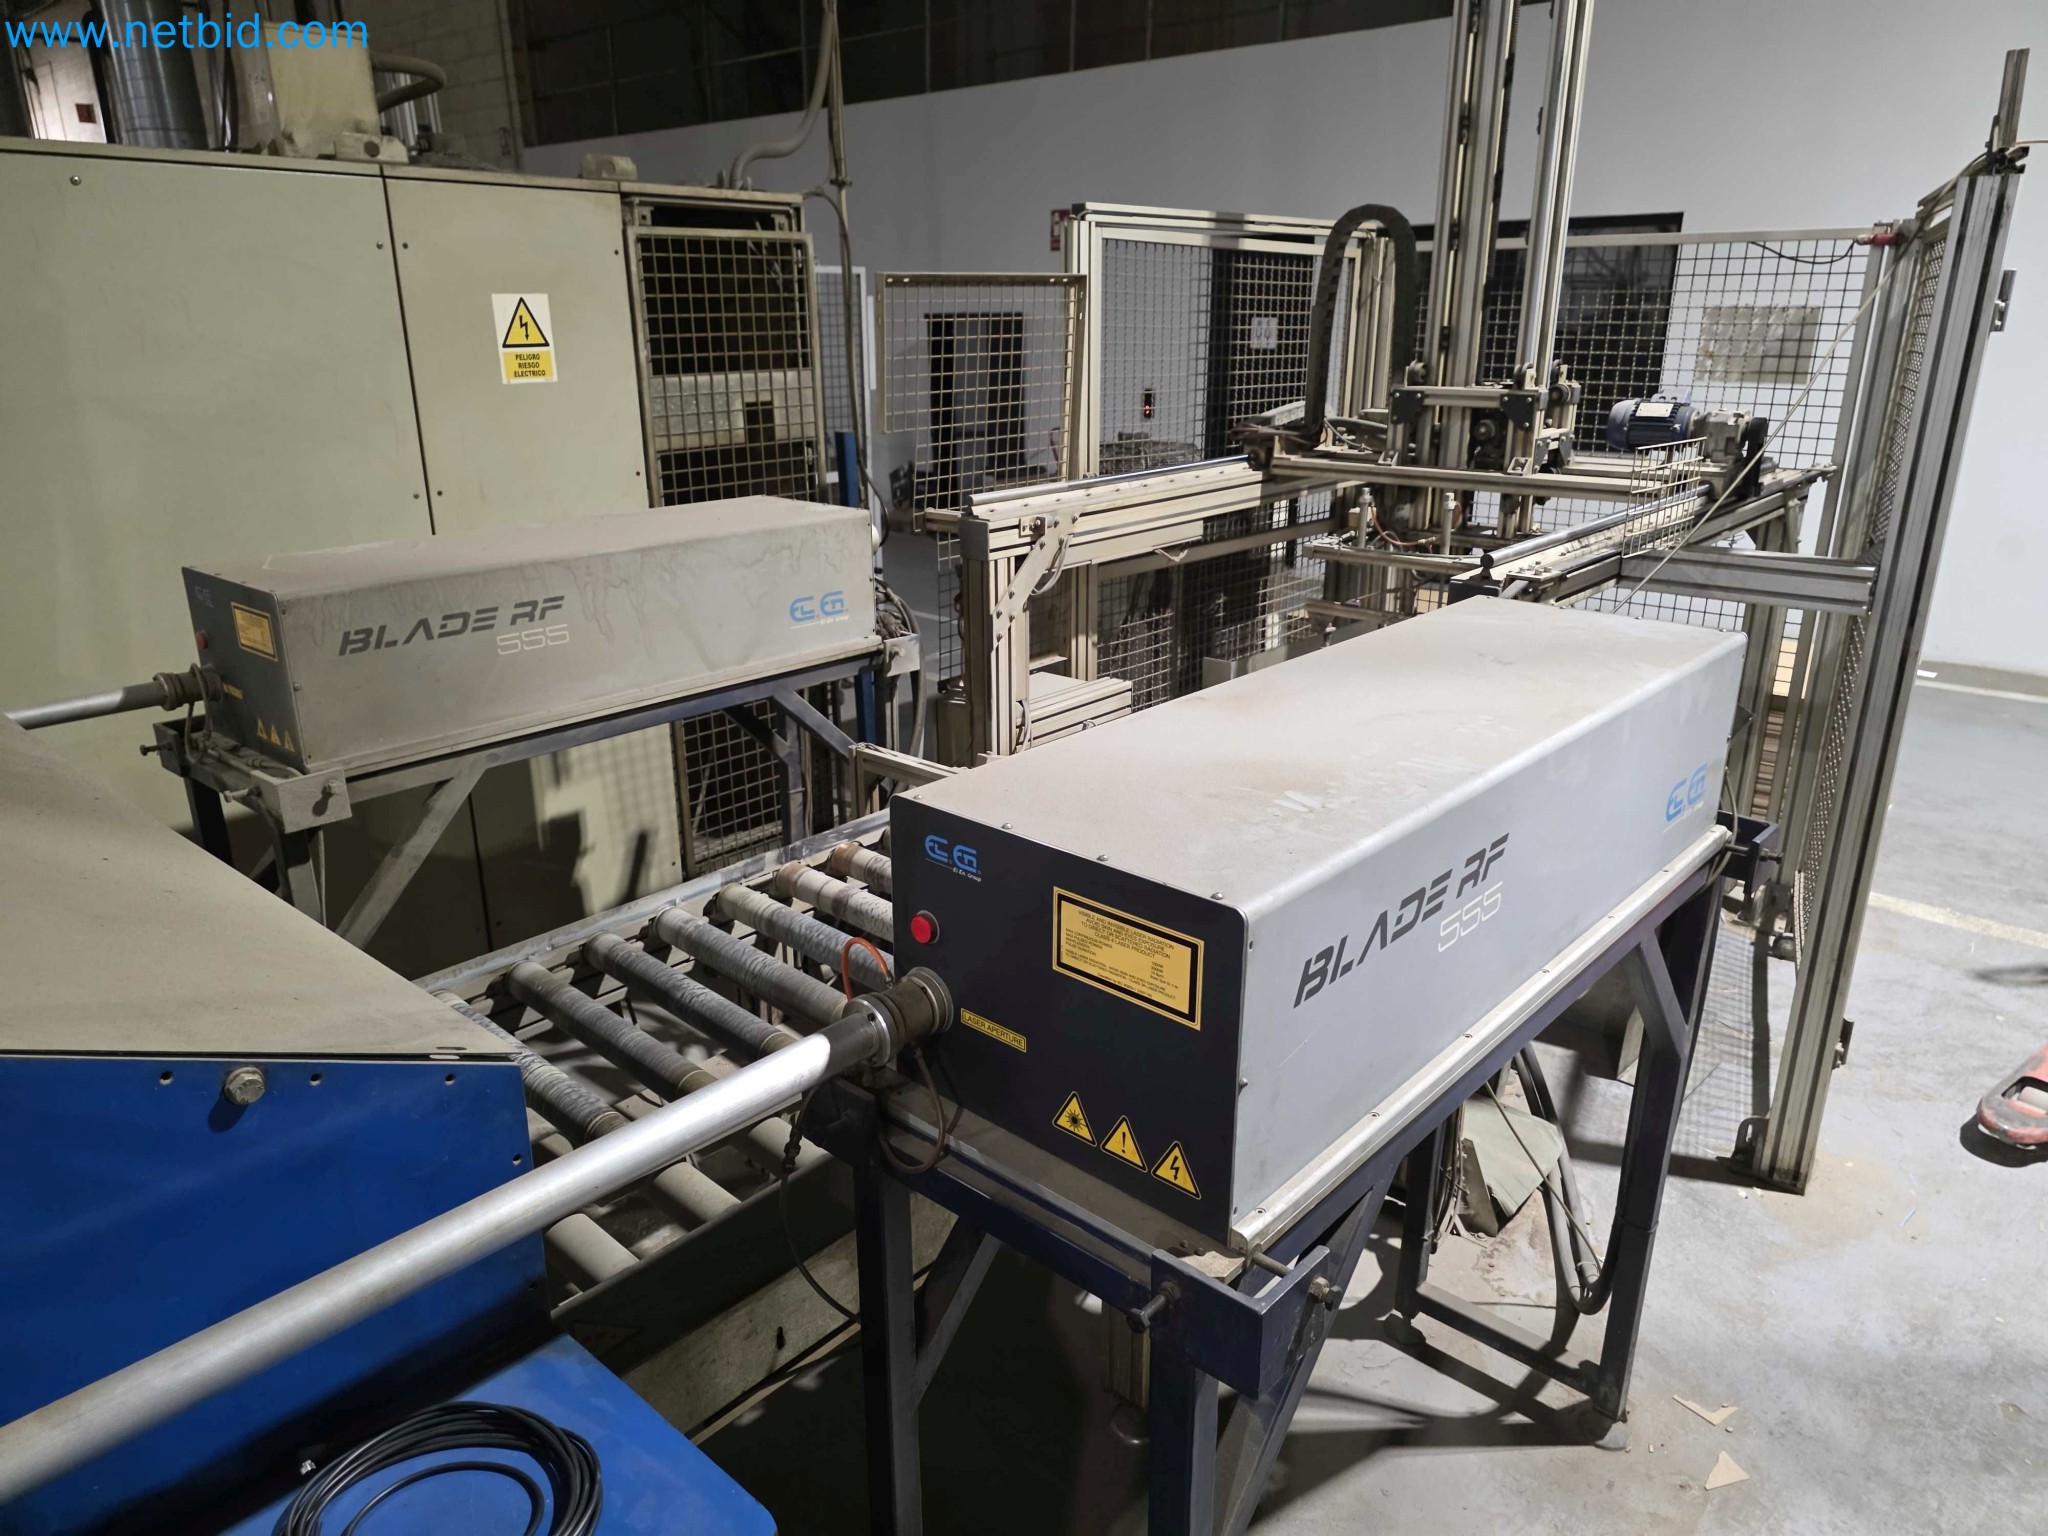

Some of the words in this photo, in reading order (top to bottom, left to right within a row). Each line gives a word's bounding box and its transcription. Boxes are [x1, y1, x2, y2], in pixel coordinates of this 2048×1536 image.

[514, 370, 546, 378] ELECTRICO
[515, 353, 540, 361] PELIGRO
[338, 606, 499, 656] BLADE
[510, 595, 565, 625] RF
[1086, 917, 1100, 927] AVOID
[1101, 923, 1112, 932] SKIN
[1113, 928, 1123, 936] AND
[1124, 932, 1137, 941] EYES
[1138, 937, 1164, 951] EXPOSURE
[1293, 868, 1453, 1009] BLADE
[1455, 832, 1510, 900] RF
[1088, 923, 1105, 934] DIRECT
[1114, 933, 1142, 948] SCATTERED
[1144, 944, 1170, 959] RADIATION
[1094, 931, 1109, 941] CLASS
[1114, 939, 1130, 949] LASER
[1131, 945, 1155, 959] PRODUCT
[1130, 929, 1146, 939] LASER
[1147, 935, 1173, 950] RADIATION
[964, 1013, 986, 1029] LASER
[987, 1024, 1024, 1047] APERTURE
